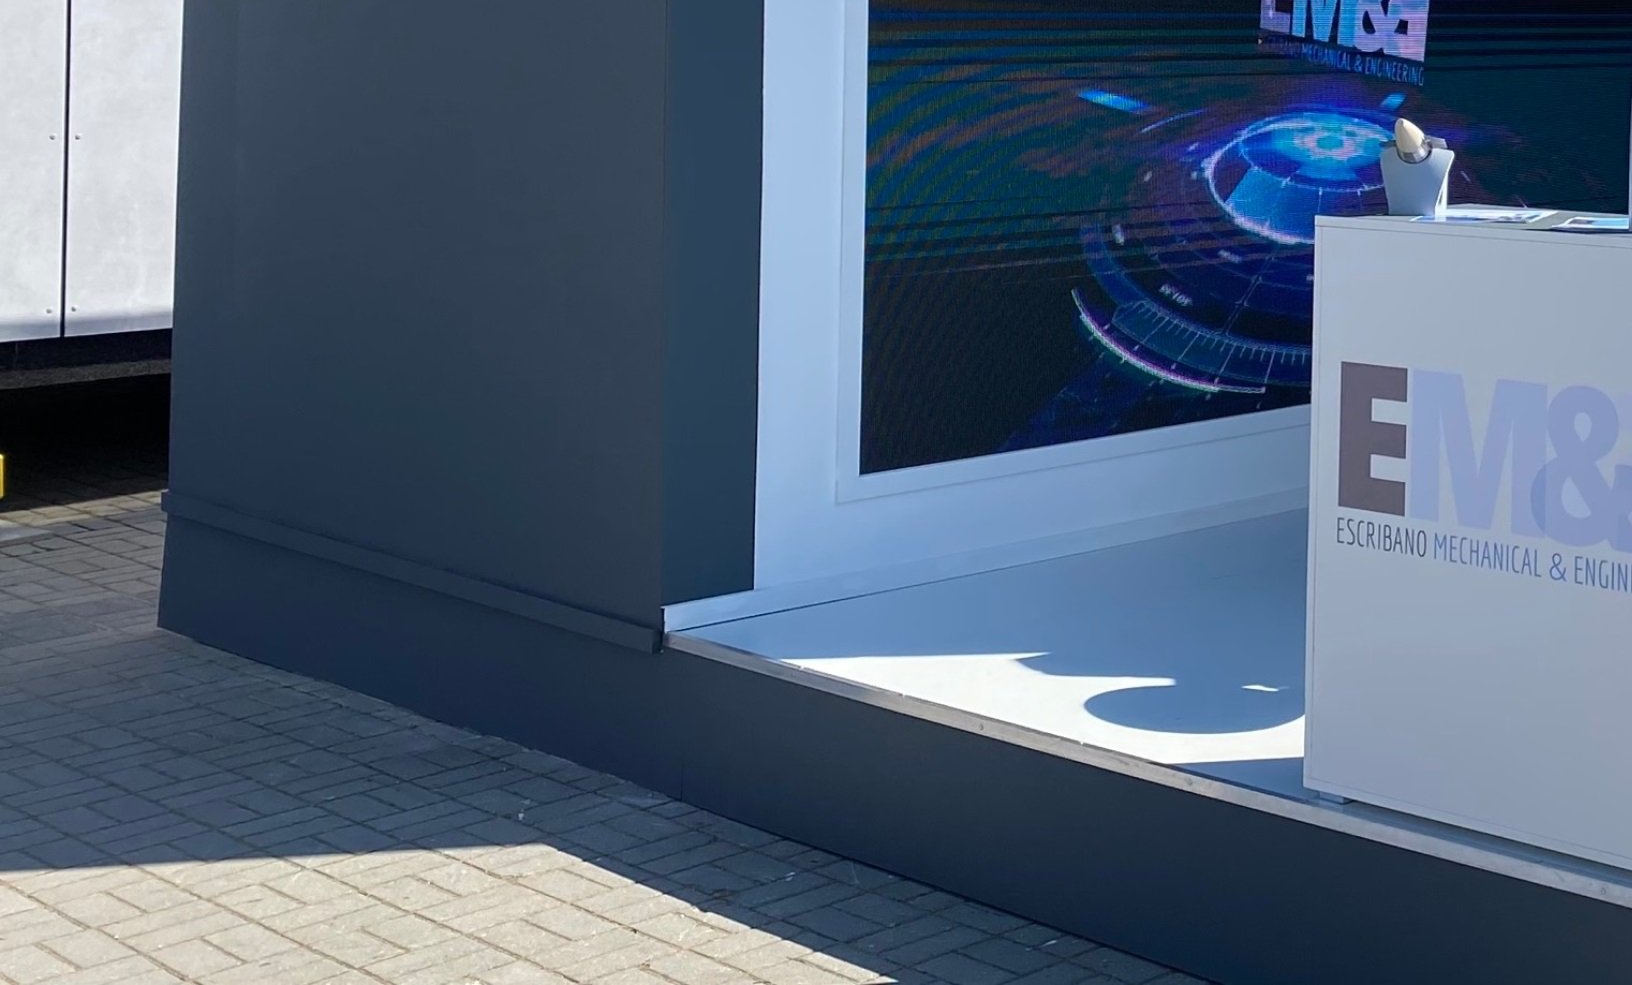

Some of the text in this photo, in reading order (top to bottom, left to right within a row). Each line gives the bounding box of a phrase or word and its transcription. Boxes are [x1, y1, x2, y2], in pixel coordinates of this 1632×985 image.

[1365, 55, 1425, 86] ENGINEERING
[1336, 517, 1427, 558] ESCRIBANO
[1433, 532, 1542, 578] MECHANICAL
[1549, 552, 1568, 583] &
